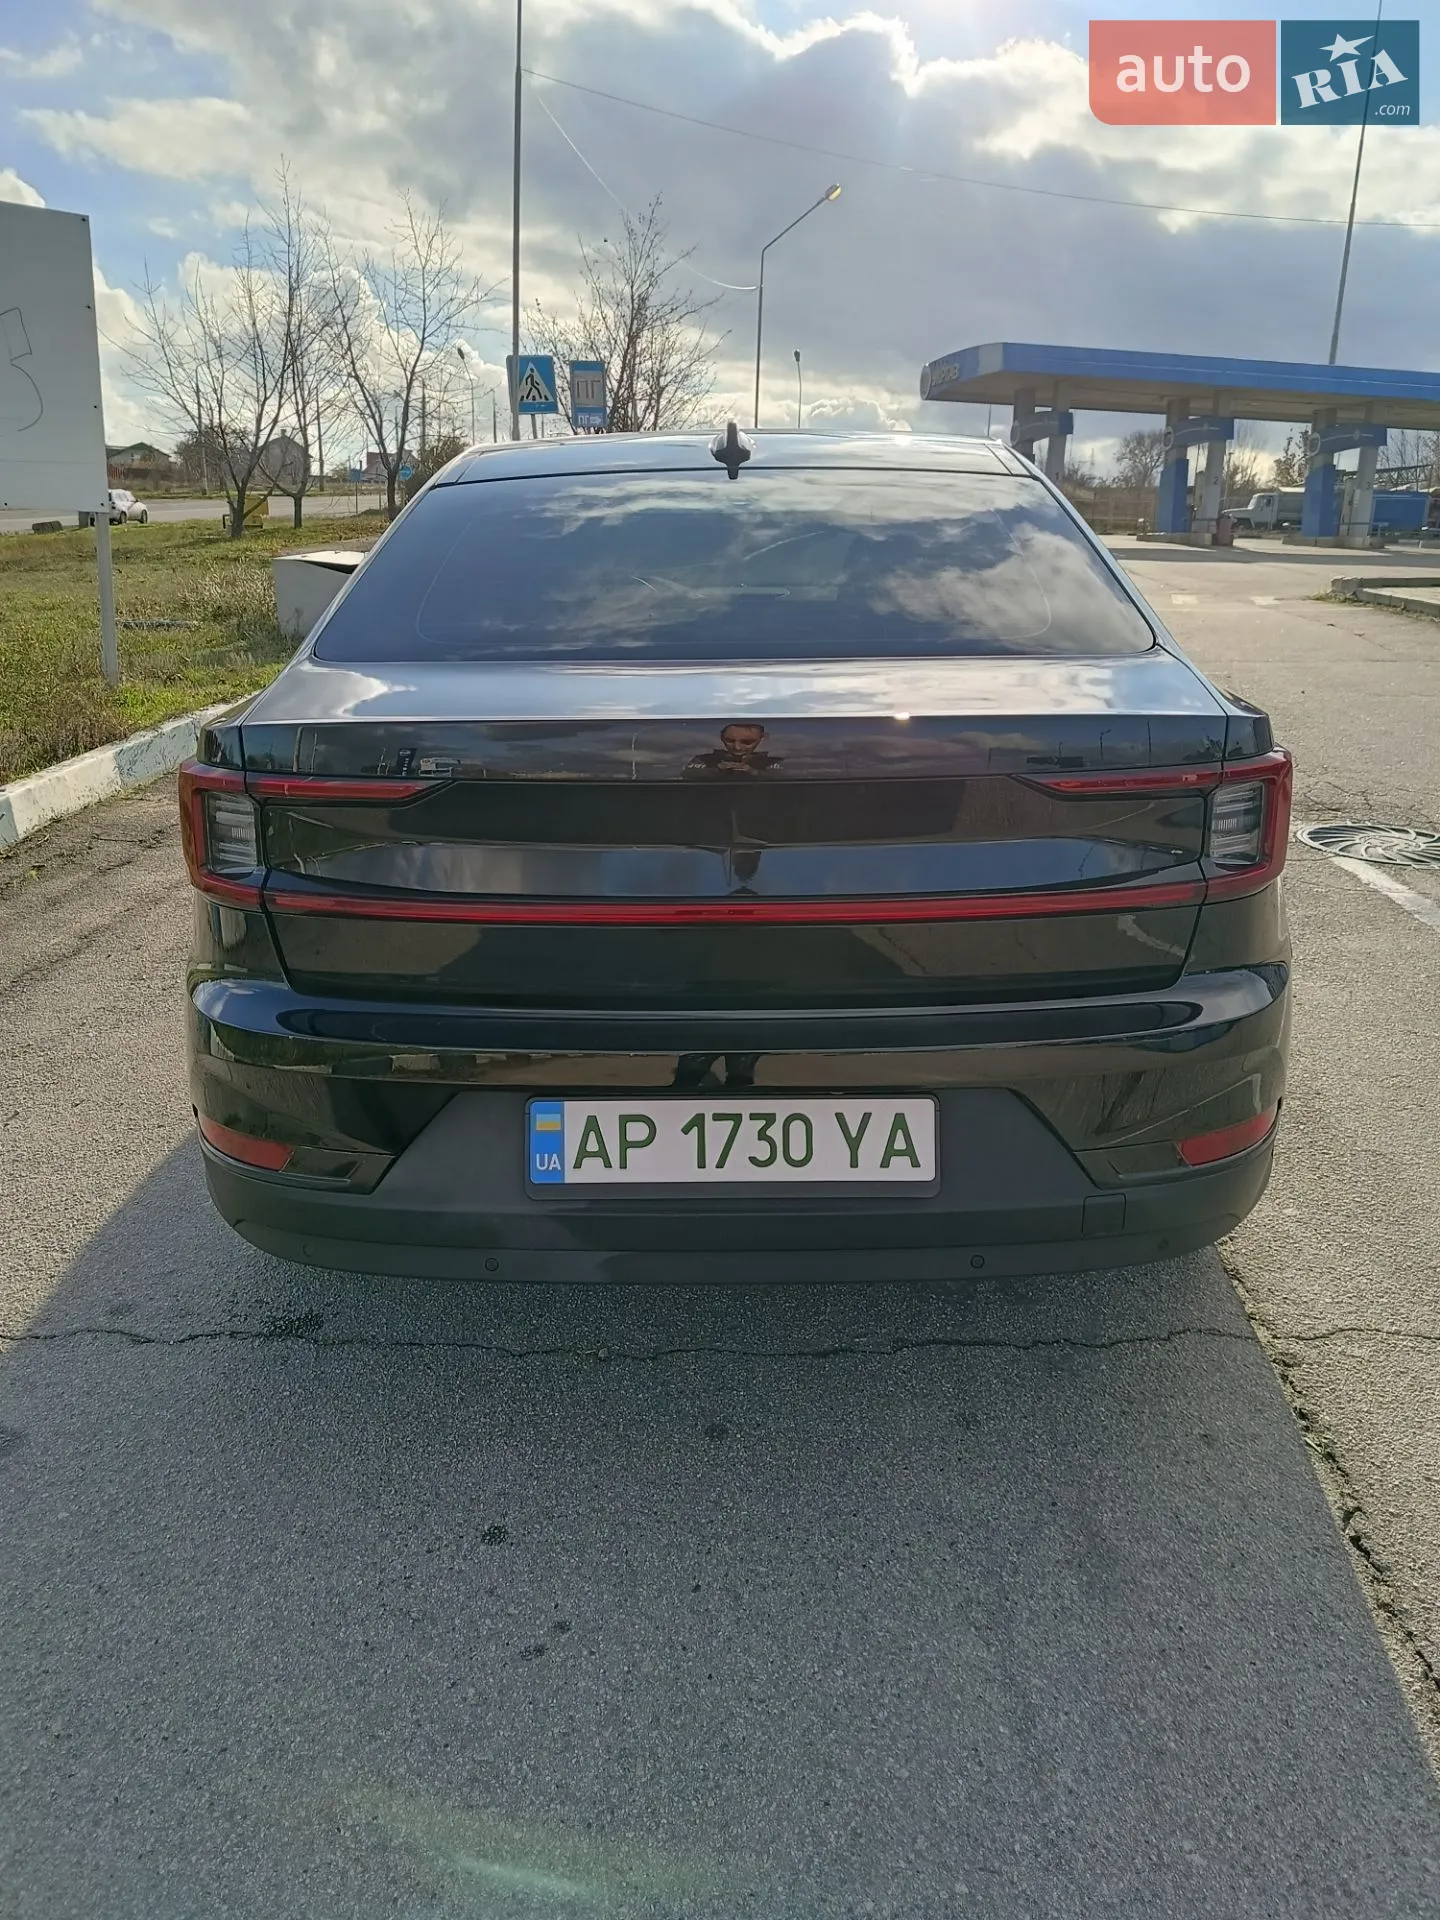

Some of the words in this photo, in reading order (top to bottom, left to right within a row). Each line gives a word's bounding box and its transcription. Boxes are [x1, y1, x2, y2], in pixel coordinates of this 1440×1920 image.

[573, 1115, 657, 1169] AP
[681, 1112, 813, 1168] 1730
[834, 1112, 921, 1168] YA
[536, 1153, 561, 1171] UA
